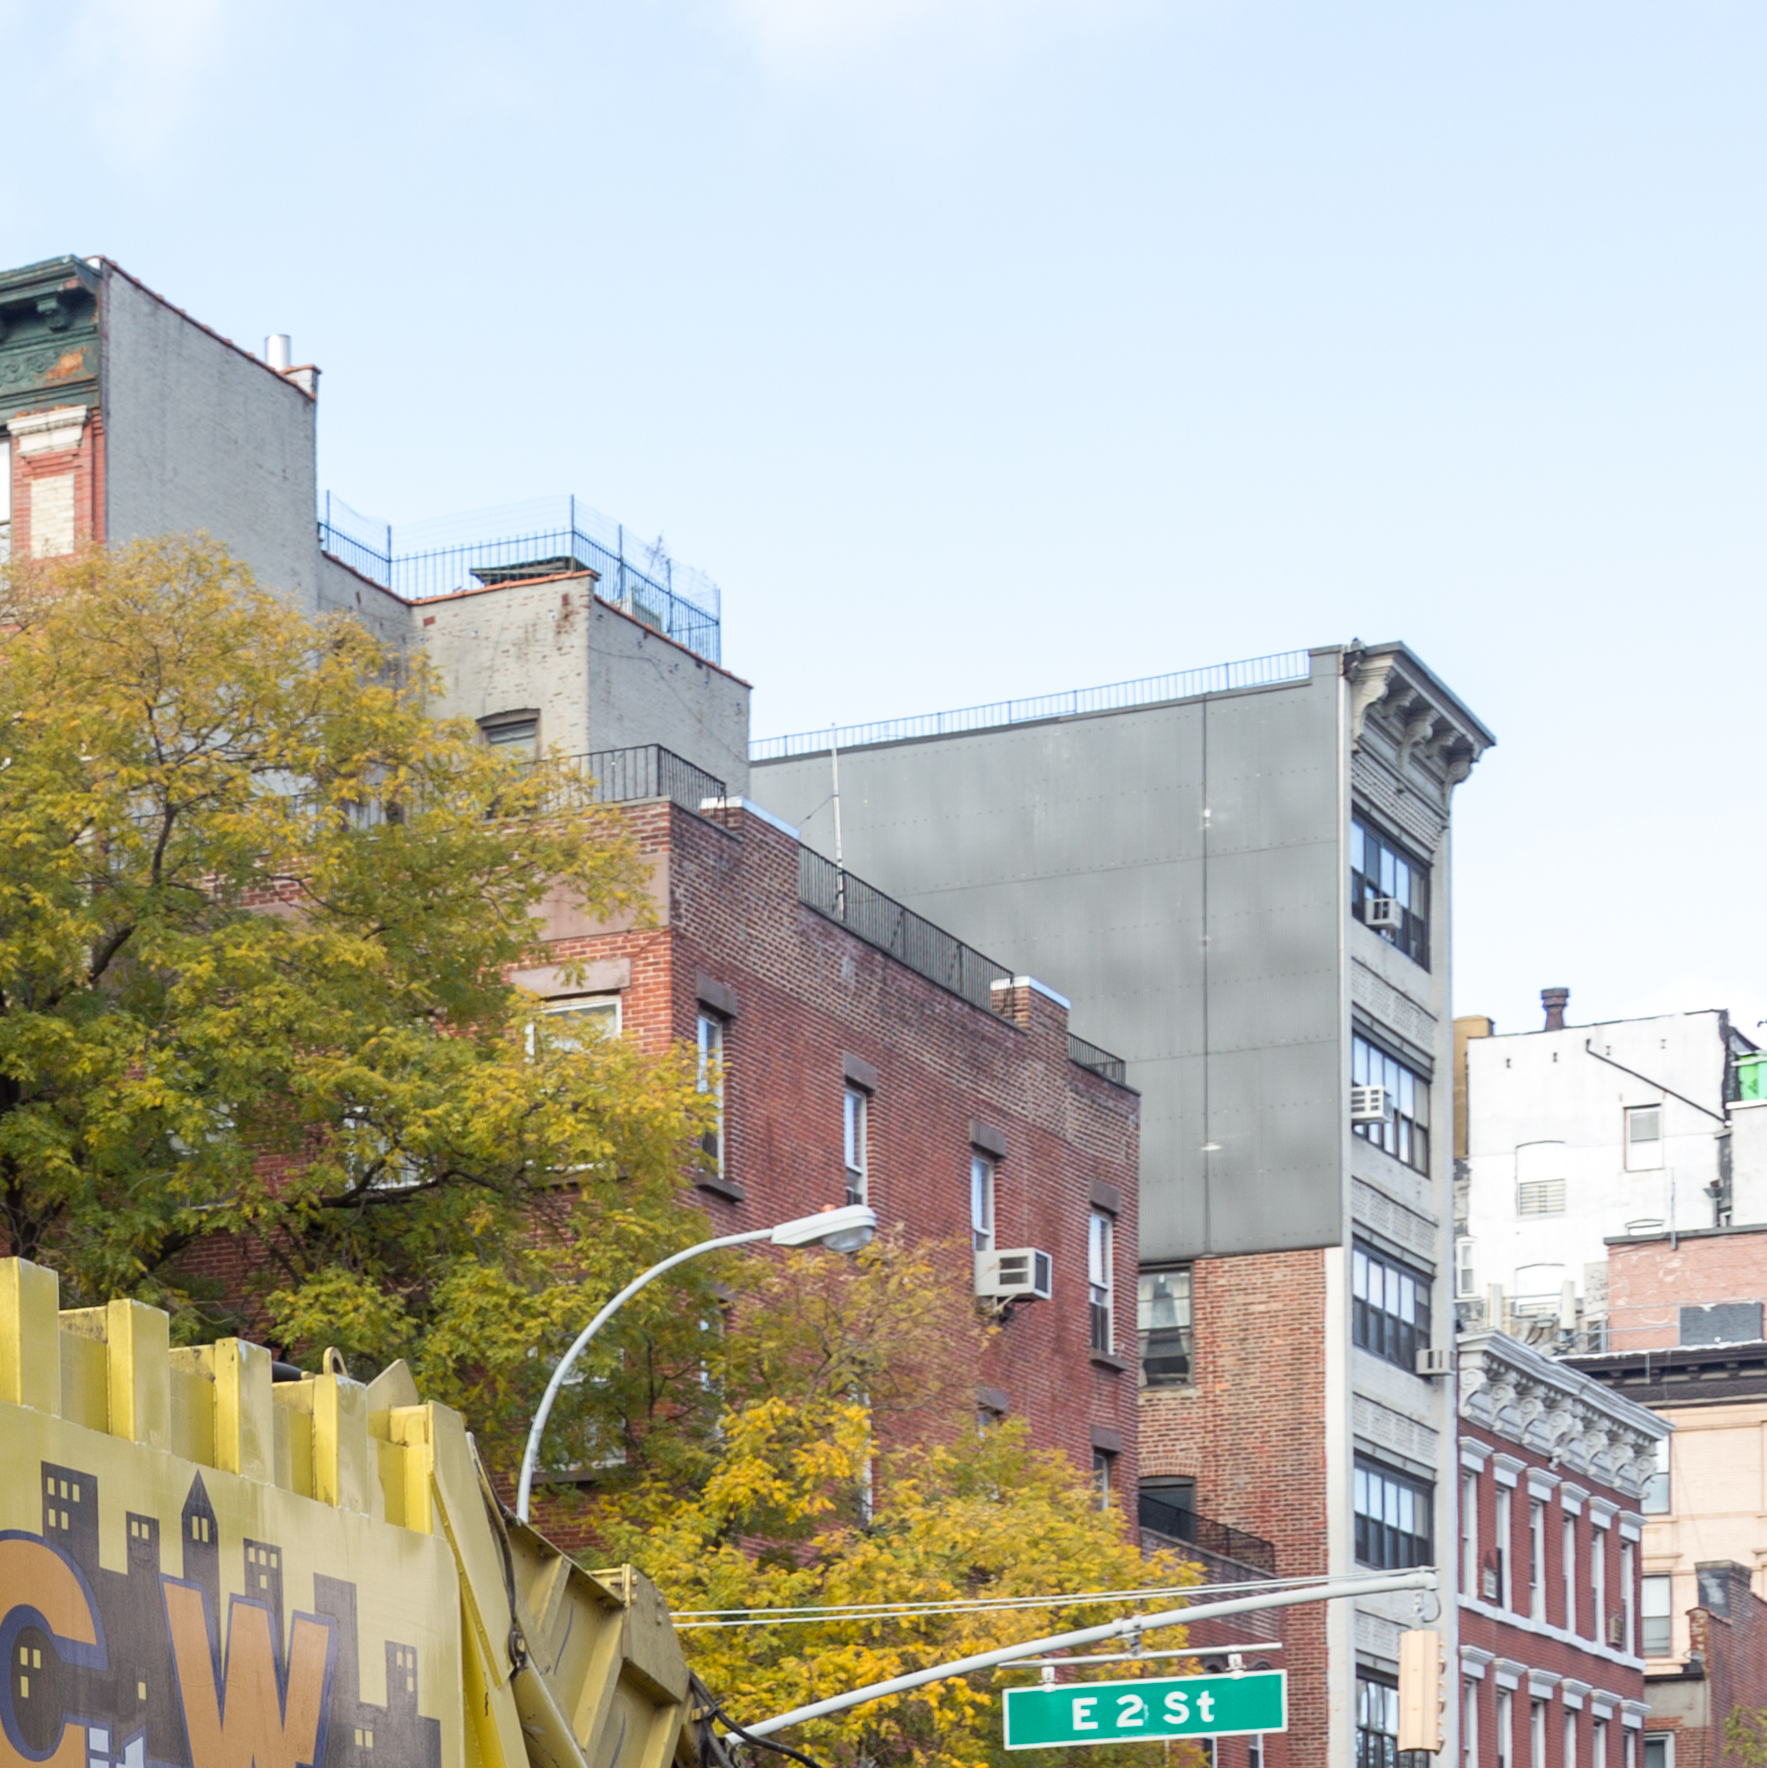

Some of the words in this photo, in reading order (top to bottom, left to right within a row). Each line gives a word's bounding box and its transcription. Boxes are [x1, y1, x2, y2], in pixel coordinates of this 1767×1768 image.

[1071, 1696, 1099, 1731] E
[1115, 1693, 1144, 1728] 2
[1162, 1689, 1215, 1725] St
